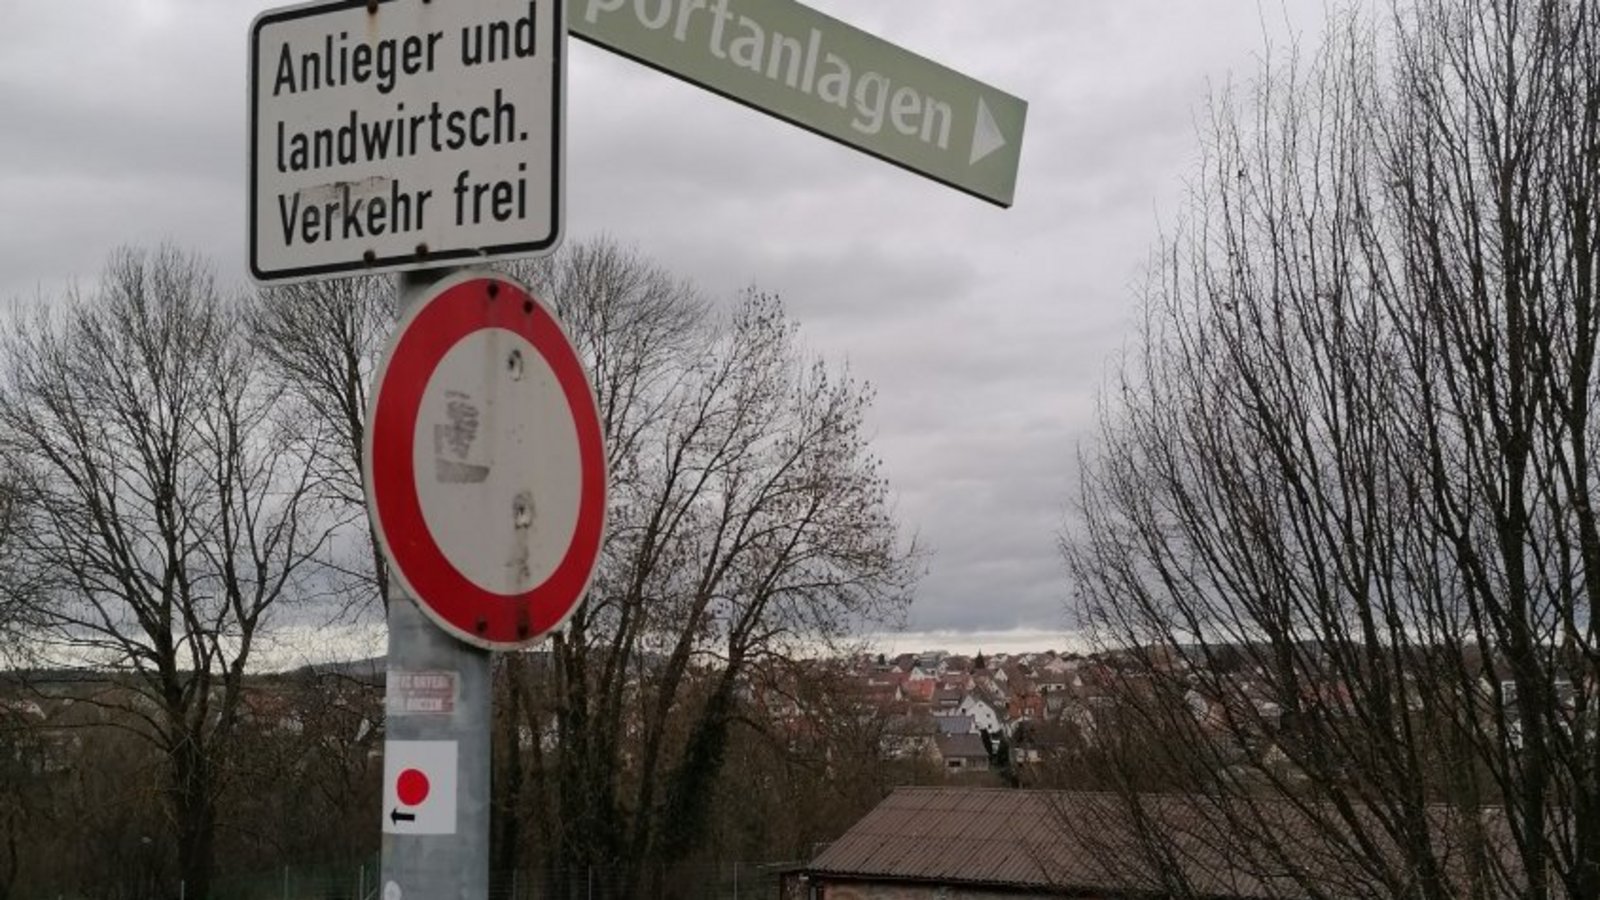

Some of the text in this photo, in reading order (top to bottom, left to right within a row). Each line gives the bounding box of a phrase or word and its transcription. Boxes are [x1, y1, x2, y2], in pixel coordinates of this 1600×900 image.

[272, 0, 537, 95] Anlieger und
[276, 88, 529, 173] landwirtsch.
[278, 162, 527, 247] Verkehr frei
